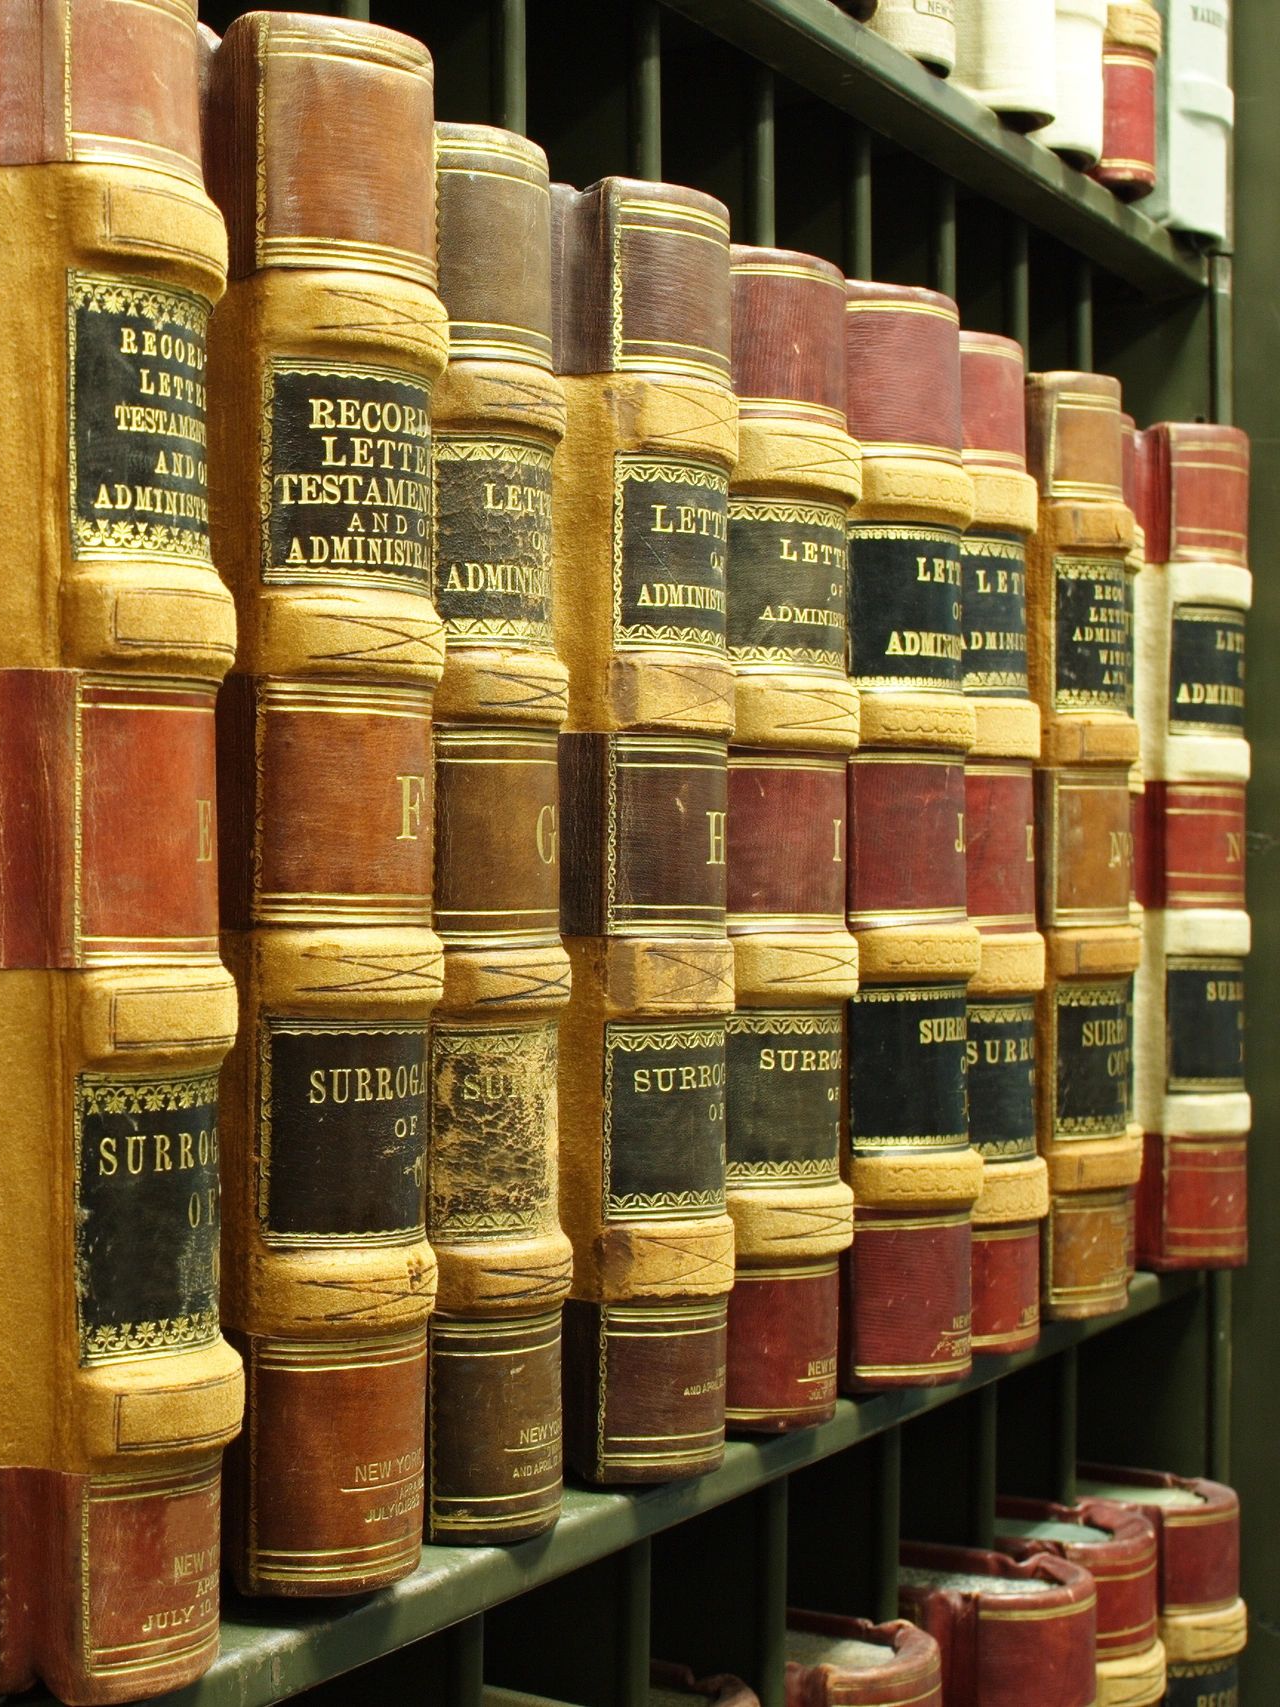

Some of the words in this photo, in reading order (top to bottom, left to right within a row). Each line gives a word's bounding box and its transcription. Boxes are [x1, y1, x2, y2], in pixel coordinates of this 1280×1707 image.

[120, 327, 203, 371] RECORD
[154, 450, 195, 480] AND
[347, 512, 408, 536] AND
[396, 774, 425, 840] F
[195, 799, 212, 862] E
[706, 811, 726, 865] H
[394, 1115, 418, 1138] OF
[188, 1188, 217, 1229] OF
[808, 1360, 828, 1377] NEW
[520, 1424, 548, 1445] NEW
[355, 1461, 392, 1483] NEW
[513, 1465, 533, 1479] AND
[142, 1605, 195, 1633] JULY
